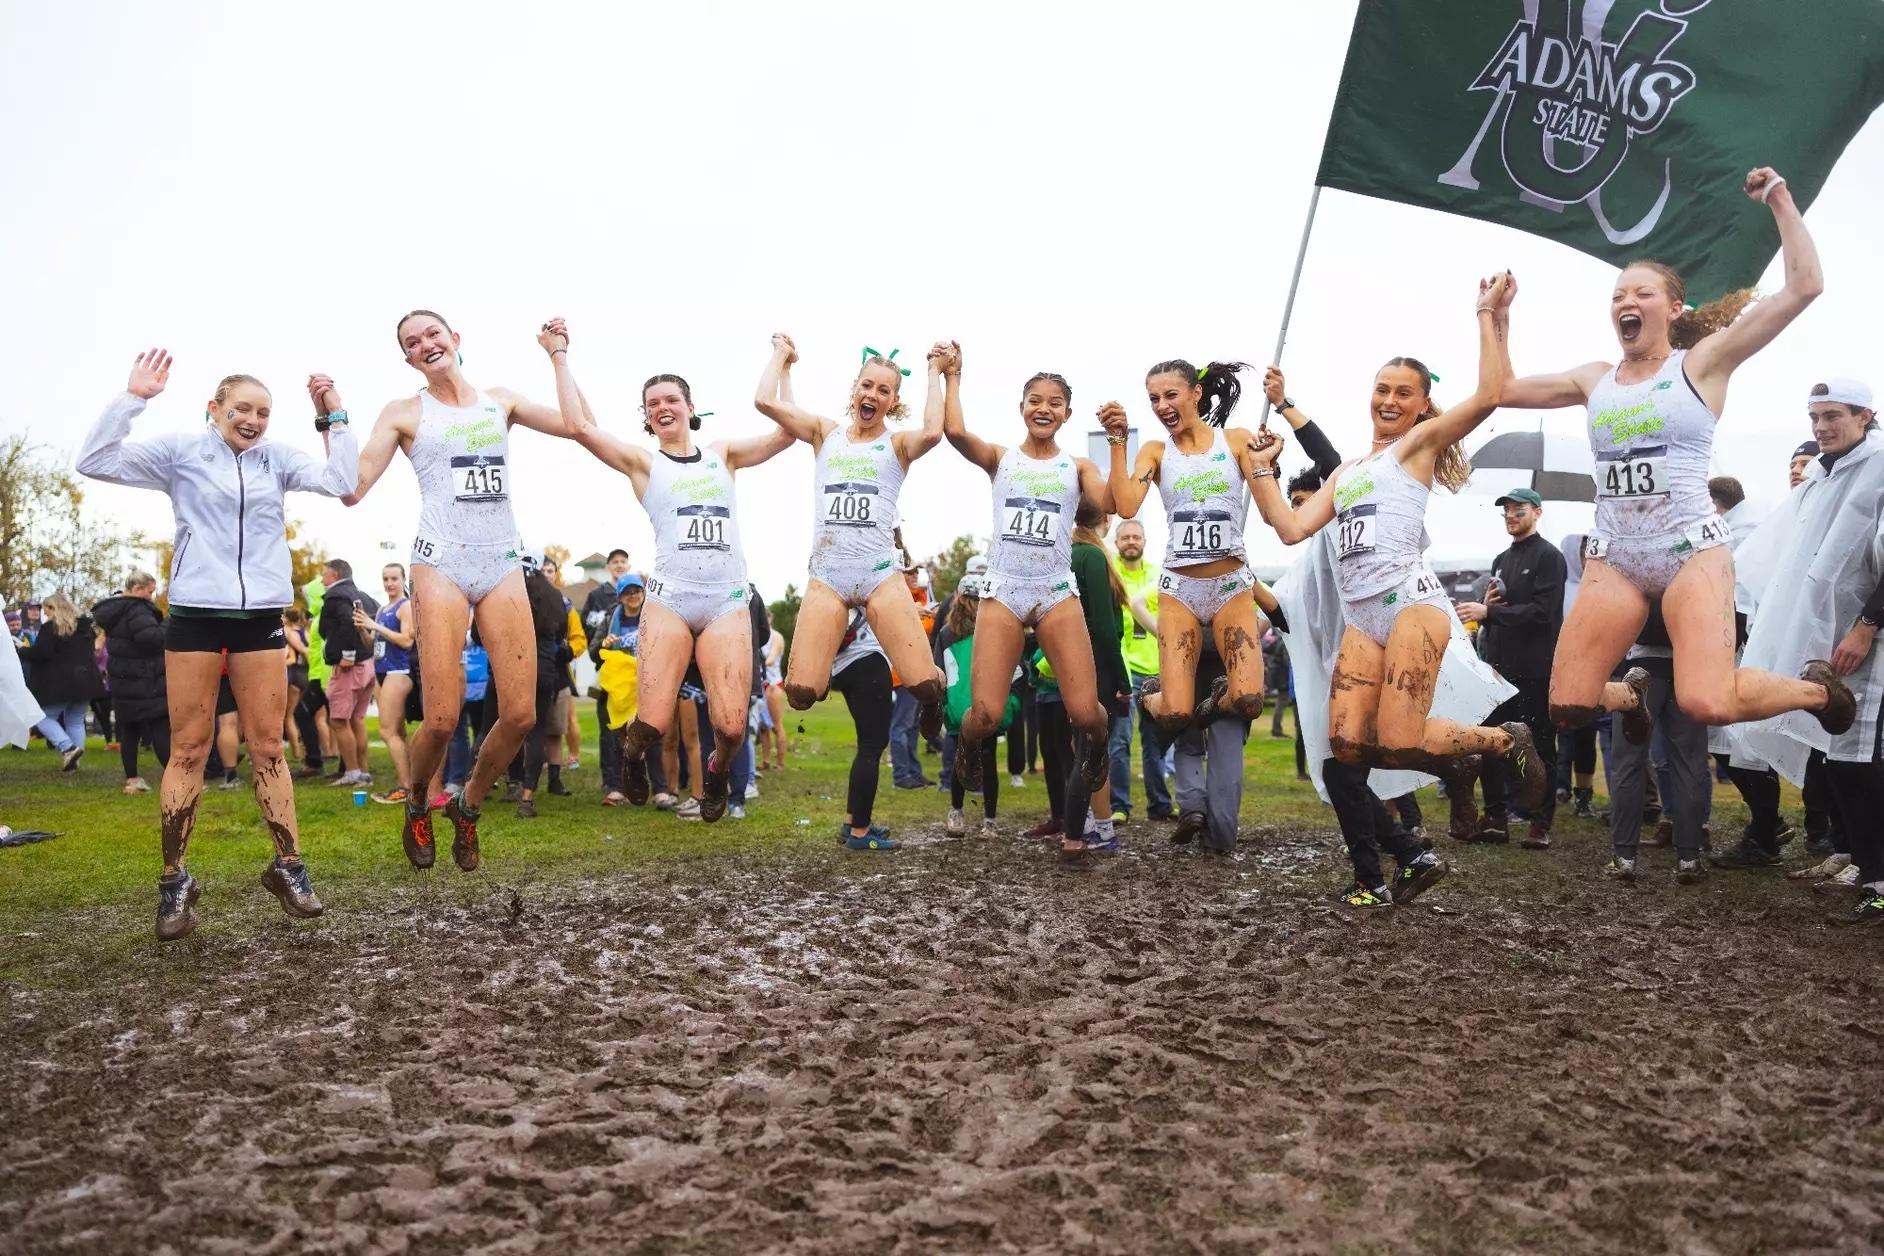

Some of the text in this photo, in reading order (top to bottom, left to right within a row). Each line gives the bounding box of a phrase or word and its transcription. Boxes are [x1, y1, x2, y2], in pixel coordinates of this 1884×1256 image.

[1493, 31, 1680, 122] ADAMS
[1533, 98, 1611, 145] STATE
[464, 468, 502, 493] 415
[1605, 462, 1655, 495] 413
[828, 496, 870, 521] 408
[687, 518, 724, 543] 401
[1009, 510, 1049, 538] 414
[1182, 524, 1222, 550] 416
[1339, 520, 1365, 552] 412
